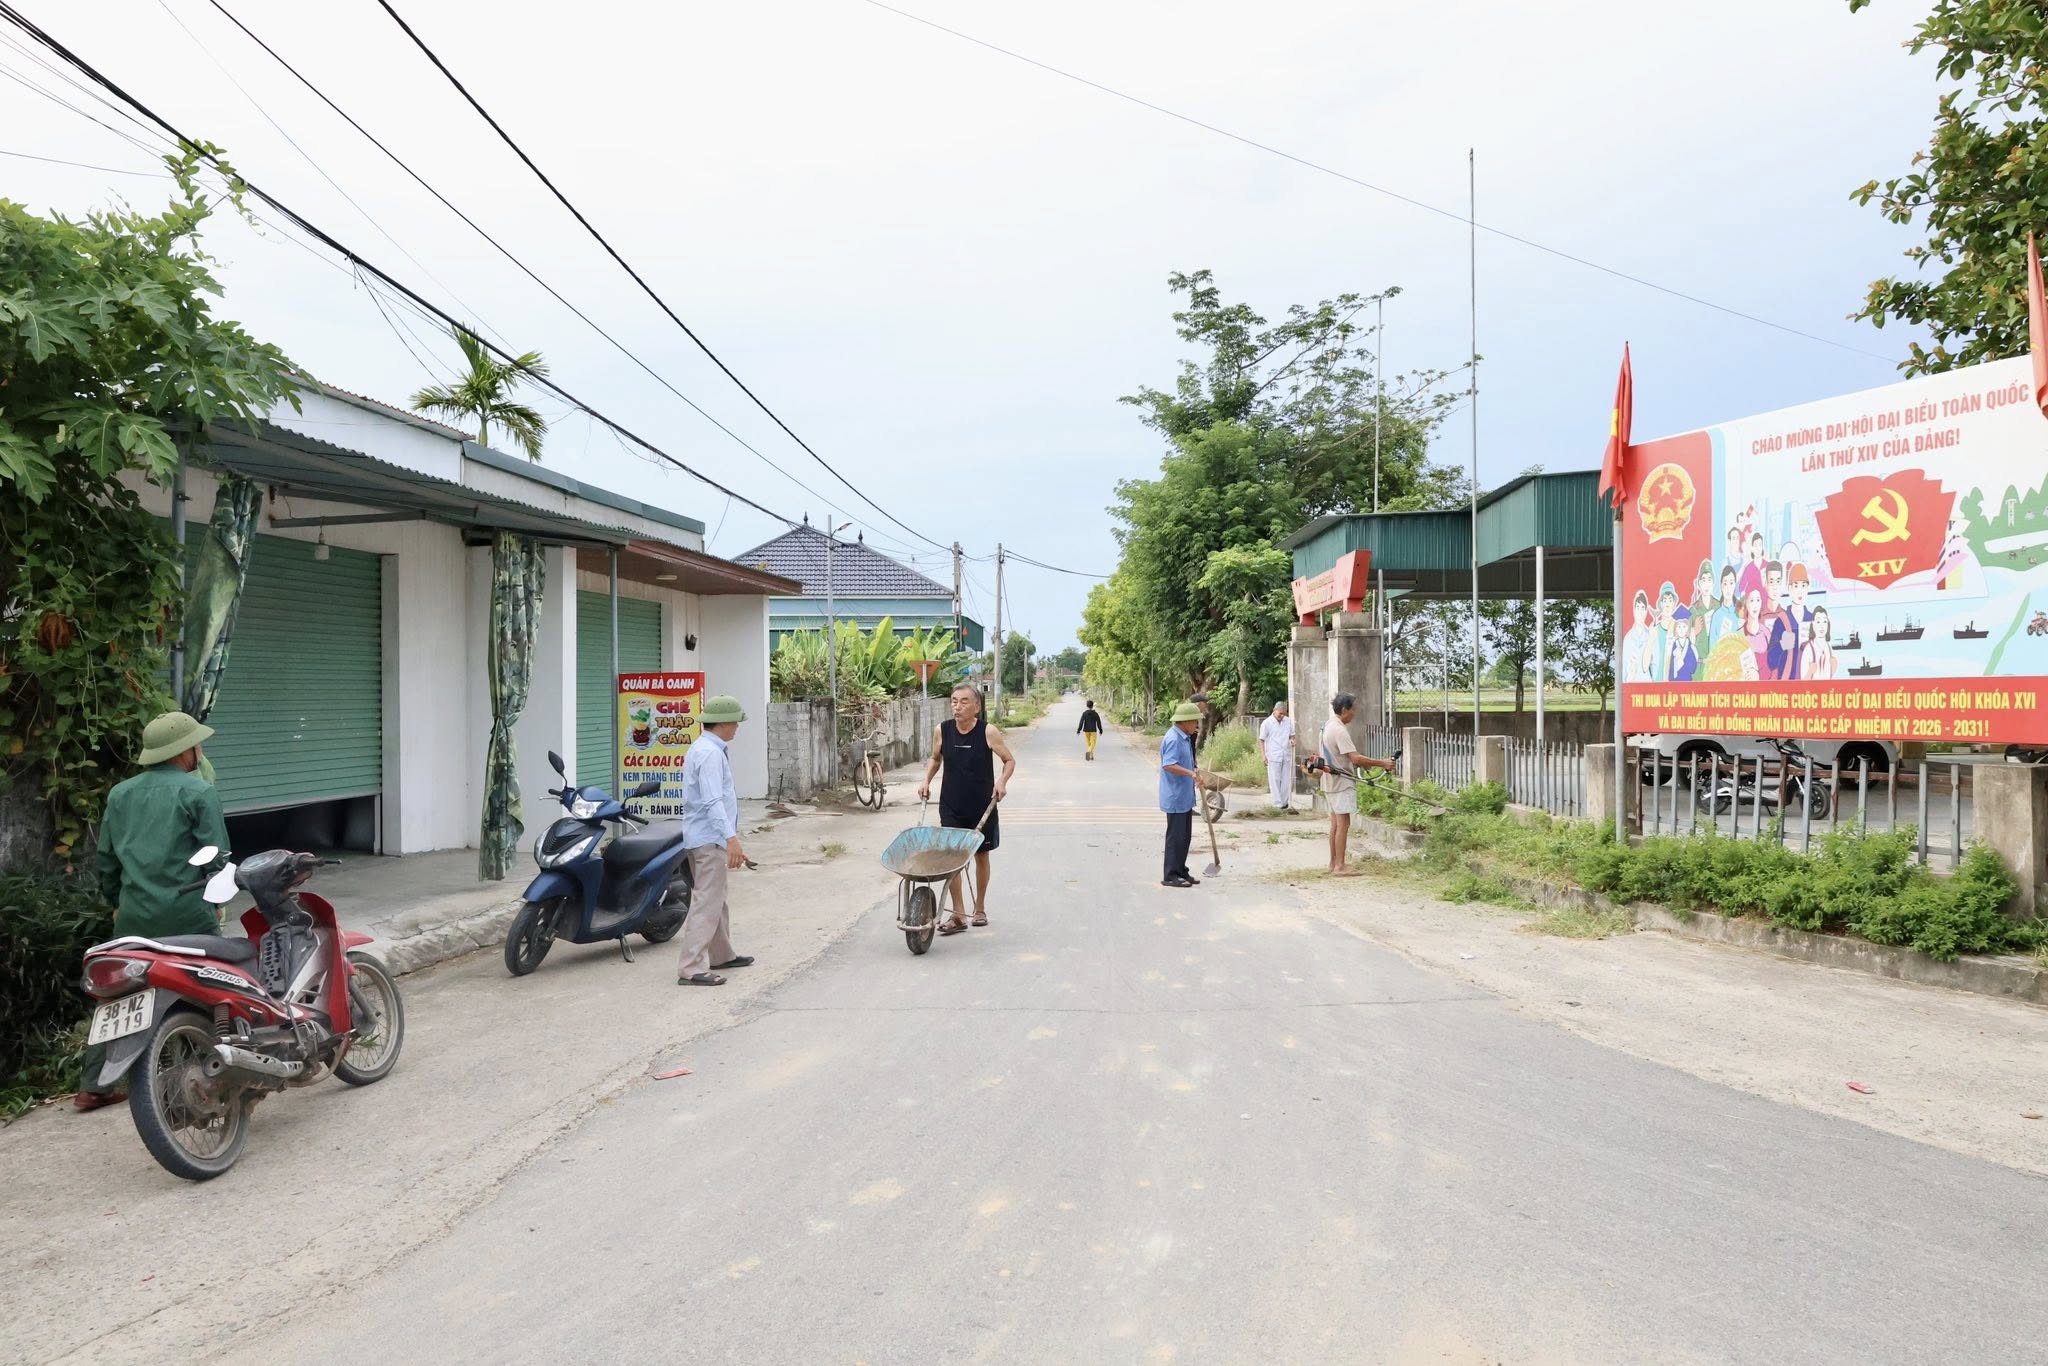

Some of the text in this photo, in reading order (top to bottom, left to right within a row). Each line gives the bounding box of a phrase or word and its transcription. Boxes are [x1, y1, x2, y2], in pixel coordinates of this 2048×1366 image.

[1752, 379, 2029, 456] CHÀO MỪNG ĐẠI HỘI ĐẠI BIỂU TOÀN QUỐC
[1829, 446, 1854, 467] THỨ
[1857, 443, 1878, 462] XIV
[1883, 434, 1910, 458] CỦA
[1915, 428, 1960, 452] ĐẢNG!
[1857, 558, 1907, 578] XIV
[622, 675, 695, 691] QUÁN BÀ OANH
[656, 699, 690, 714] CHÈ
[1631, 686, 2037, 712] THI ĐUA LẬP THÀNH TÍCH CHÀO MỪNG CUỘC BẦU CỬ ĐẠI BIỂU QUỐC HỘI KHÓA XVI
[655, 714, 694, 730] THẬP
[1658, 713, 1669, 729] VÀ
[1671, 715, 1685, 732] ĐẠI
[1687, 711, 1707, 730] BIỂU
[1709, 713, 1724, 733] HỘI
[1726, 711, 1752, 731] ĐỒNG
[1753, 714, 1781, 732] NHÂN
[1783, 714, 1804, 733] DÂN
[1807, 715, 1827, 733] CÁC
[1830, 713, 1852, 734] CẤP
[1854, 715, 1891, 738] NHIỆM
[1894, 716, 1909, 734] KỲ
[1912, 719, 1942, 736] 2026
[1953, 719, 1989, 737] 2031!
[658, 729, 691, 745] CẨM
[624, 752, 685, 770] CÁC LOẠI CH
[623, 772, 640, 782] KEM
[641, 770, 667, 782] TRÀNG
[650, 803, 672, 815] BÁNH
[102, 994, 145, 1022] 38-N2
